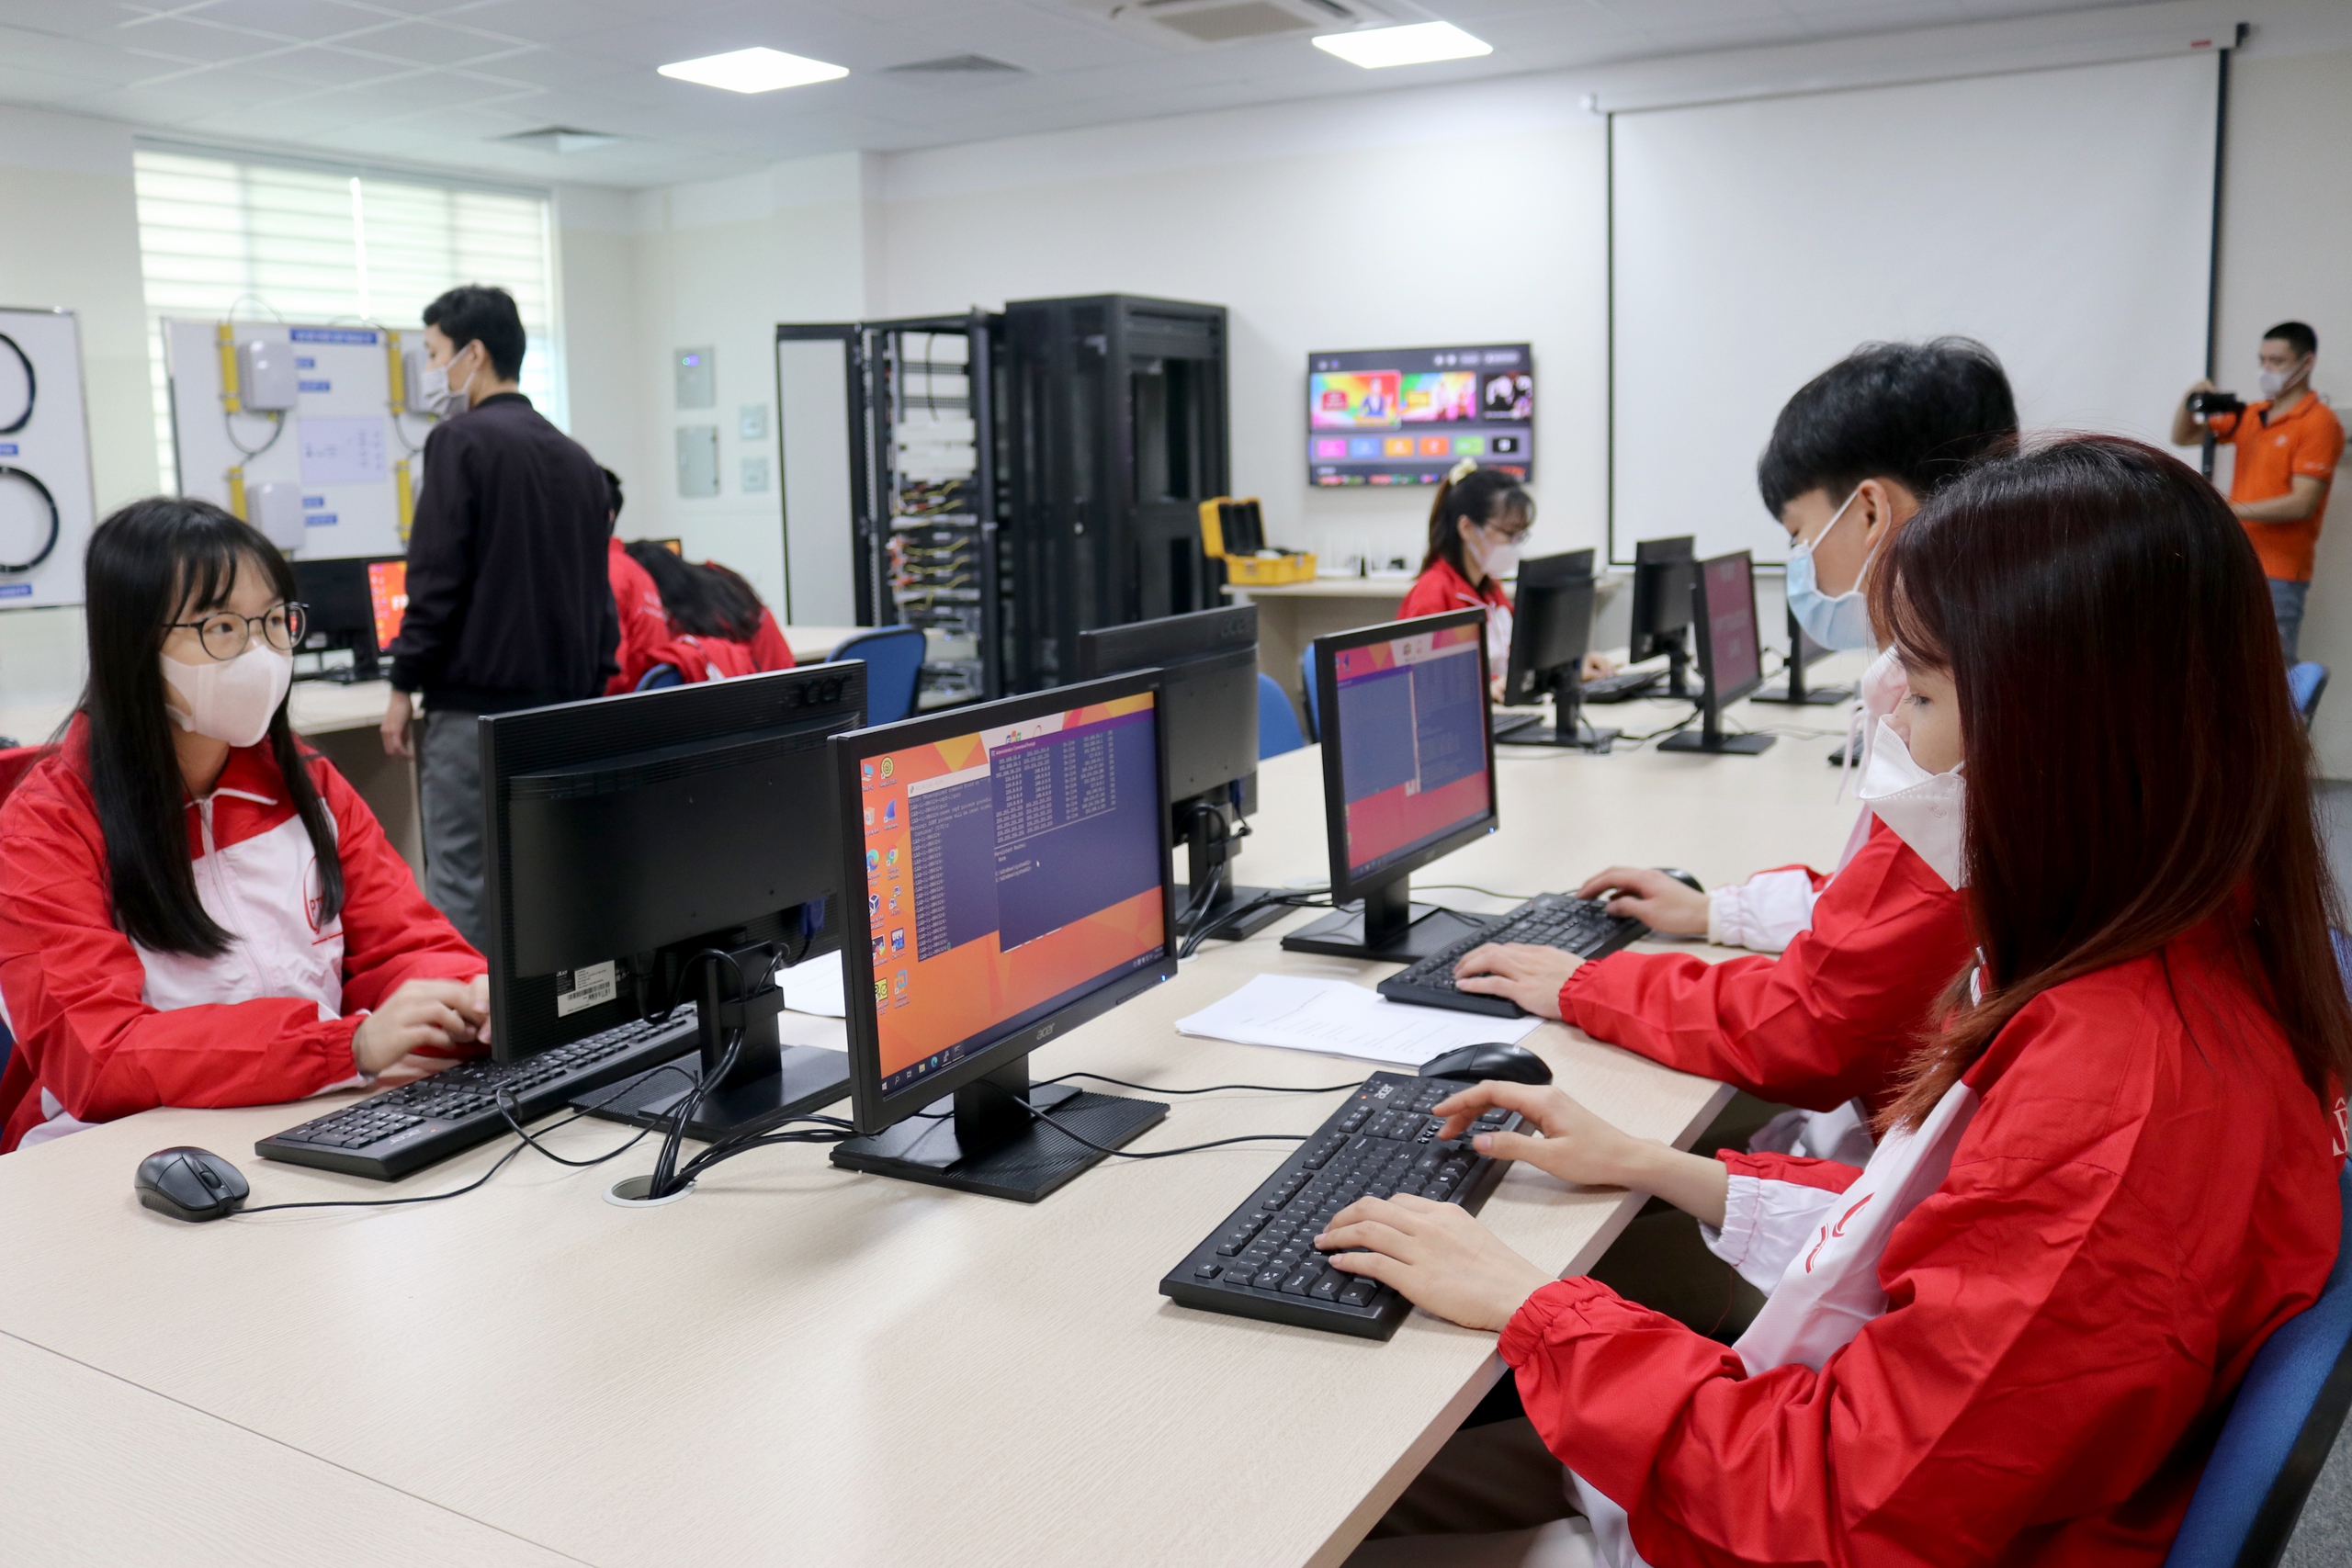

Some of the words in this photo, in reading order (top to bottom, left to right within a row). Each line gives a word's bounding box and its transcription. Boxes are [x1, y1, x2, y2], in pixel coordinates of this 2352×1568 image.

[782, 675, 853, 709] acer
[893, 930, 904, 942] DEV
[1036, 1022, 1056, 1041] acer
[1374, 1083, 1395, 1100] acer
[390, 1129, 423, 1145] acer
